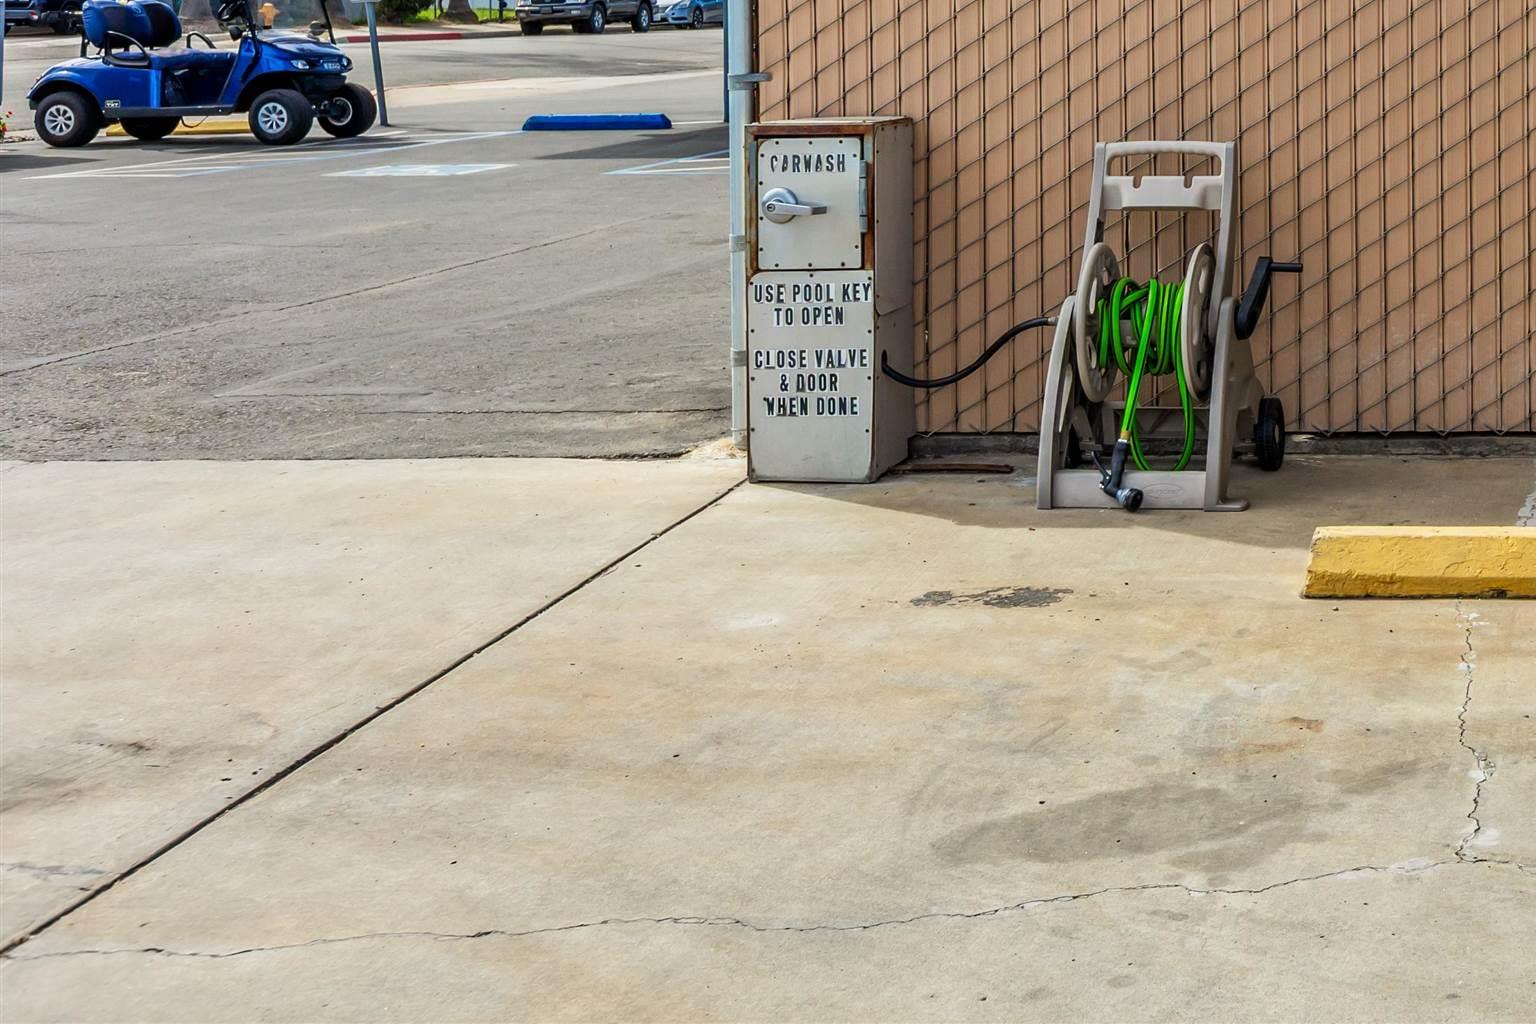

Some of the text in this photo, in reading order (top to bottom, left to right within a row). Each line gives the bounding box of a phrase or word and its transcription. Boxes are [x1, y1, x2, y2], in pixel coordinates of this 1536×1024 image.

[770, 154, 846, 173] CARWASH
[754, 283, 871, 304] USE POOL KEY
[774, 307, 844, 325] TO OPEN
[754, 349, 868, 369] CLOSE VALVE
[780, 374, 838, 392] & DOOR
[764, 397, 858, 416] WHEN DONE
